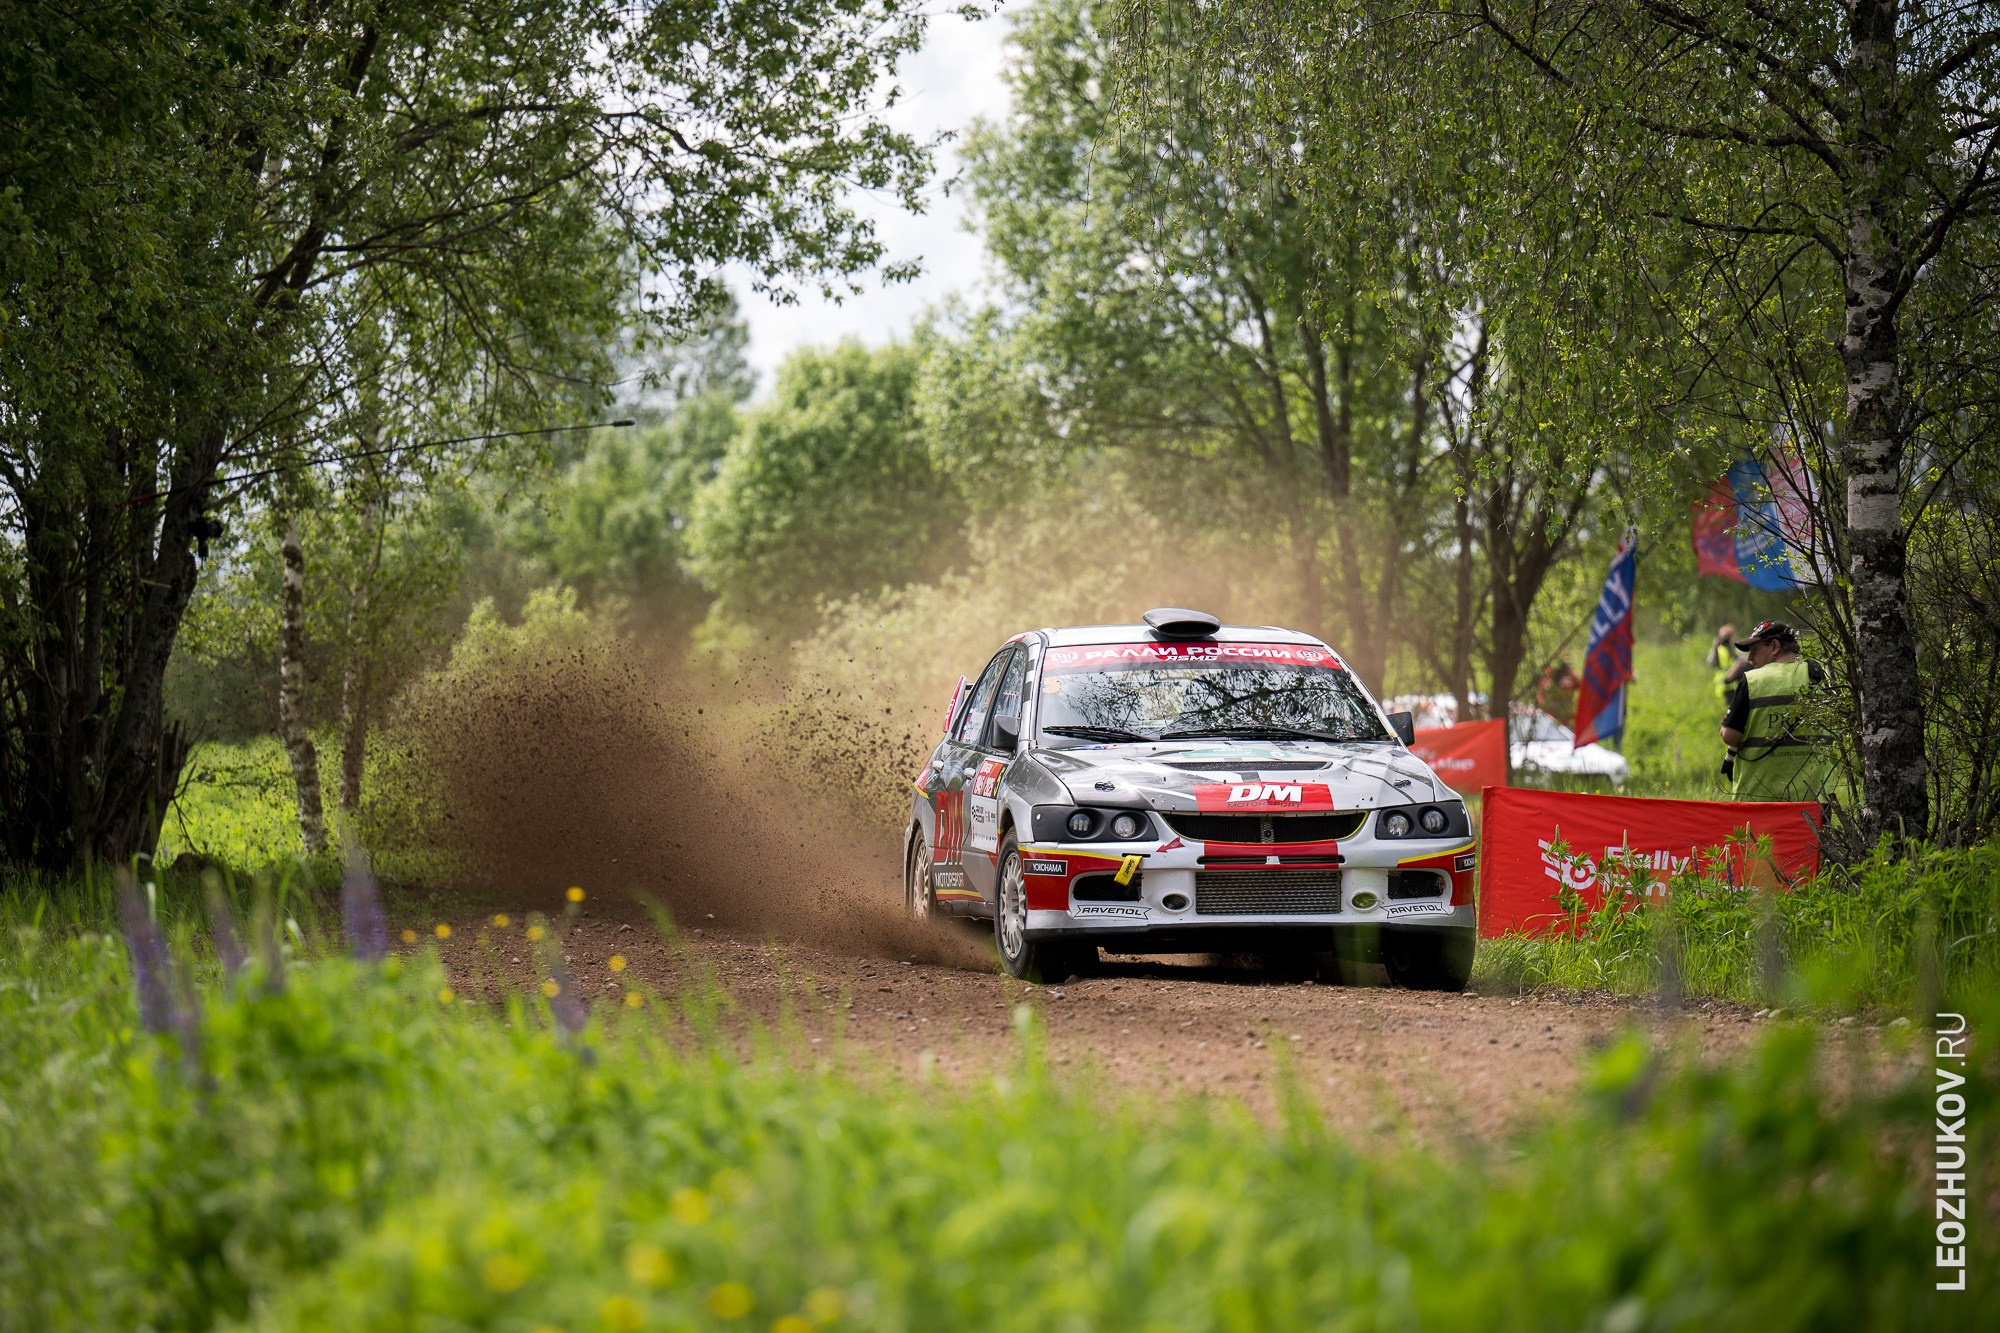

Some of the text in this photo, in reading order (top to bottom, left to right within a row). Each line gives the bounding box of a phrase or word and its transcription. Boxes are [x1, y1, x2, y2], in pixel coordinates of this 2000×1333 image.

[1186, 647, 1291, 659] РОССИИ
[1226, 784, 1303, 803] DM
[1032, 863, 1063, 873] YOKOHAMA
[1081, 907, 1142, 916] RAVENOL
[1389, 904, 1442, 914] RAVENOL
